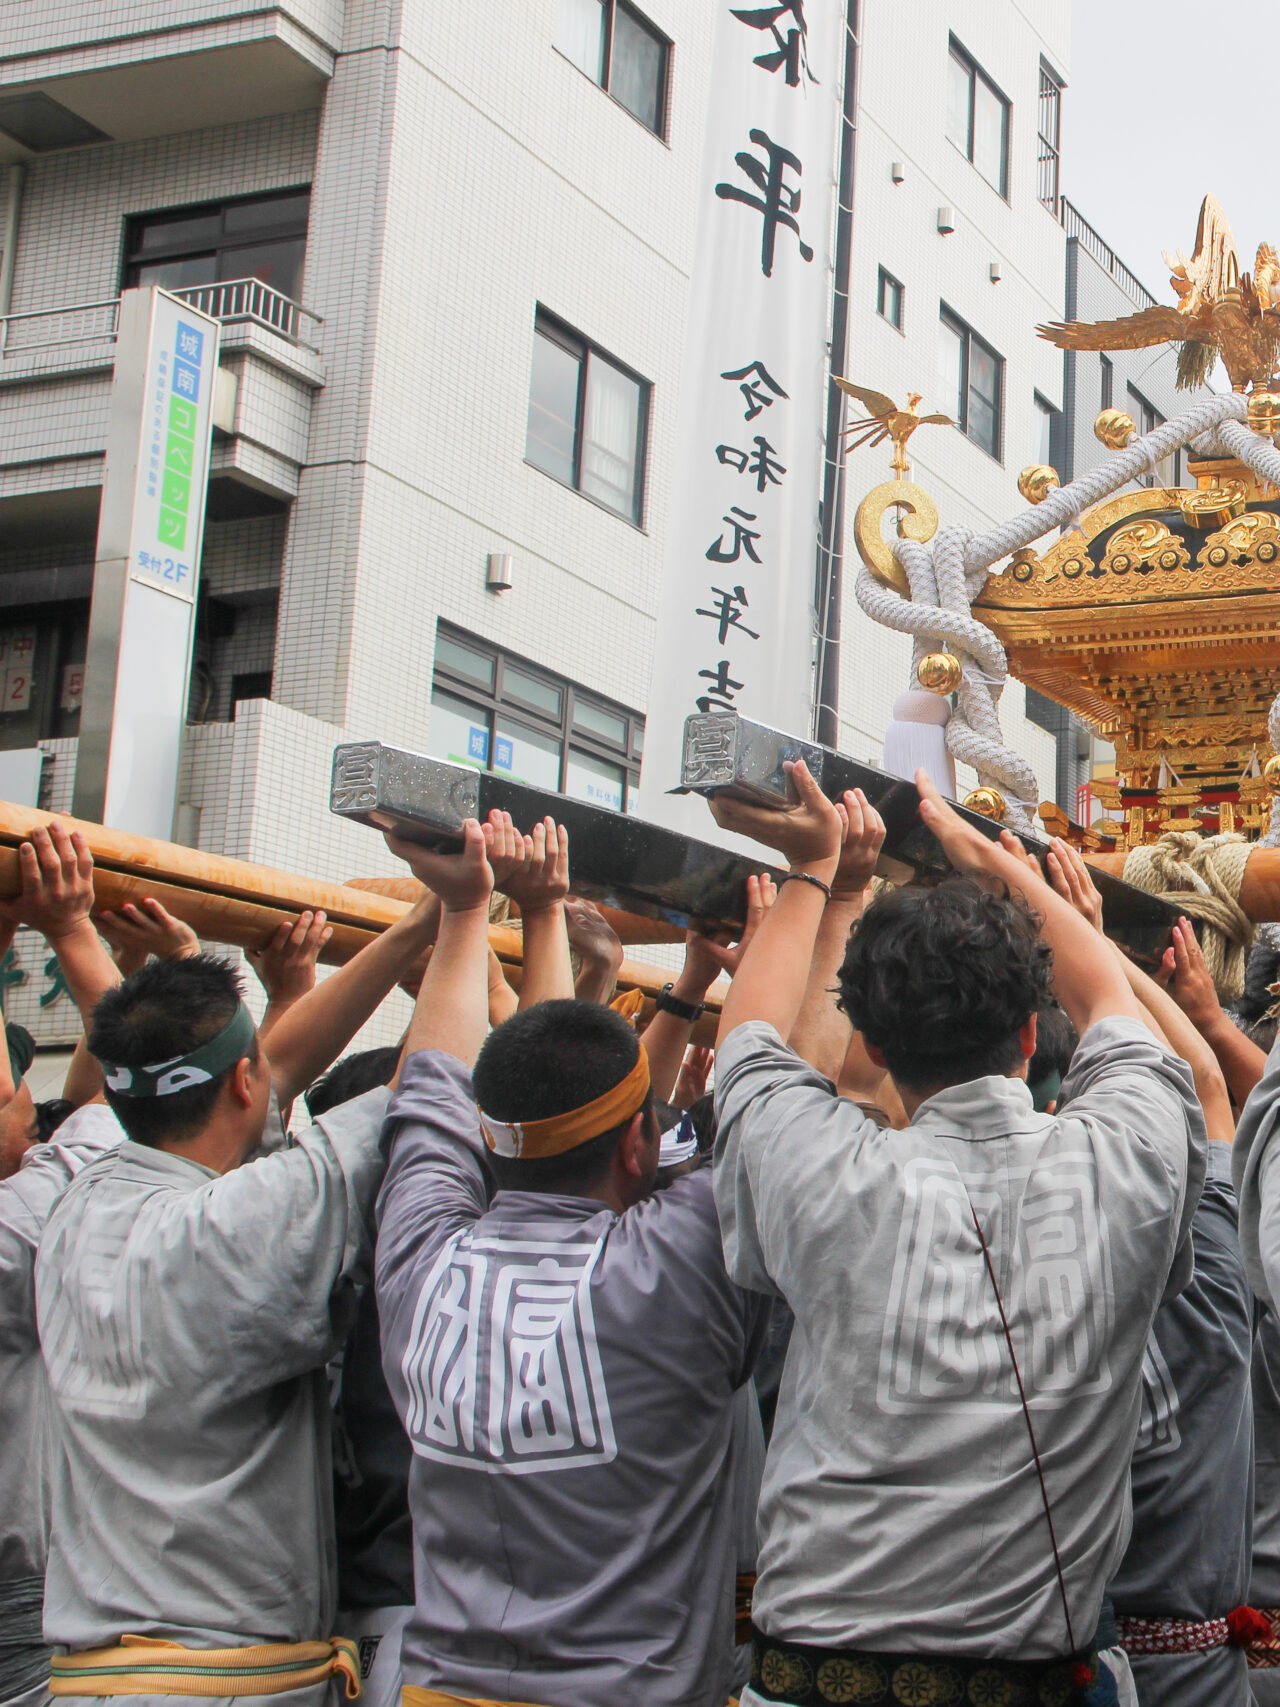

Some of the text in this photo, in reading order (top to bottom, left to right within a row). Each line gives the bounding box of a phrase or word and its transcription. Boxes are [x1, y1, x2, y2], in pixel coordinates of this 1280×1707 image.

[163, 329, 199, 539] 城南コベッツ
[138, 551, 189, 583] 受付2F
[471, 732, 510, 768] 城南
